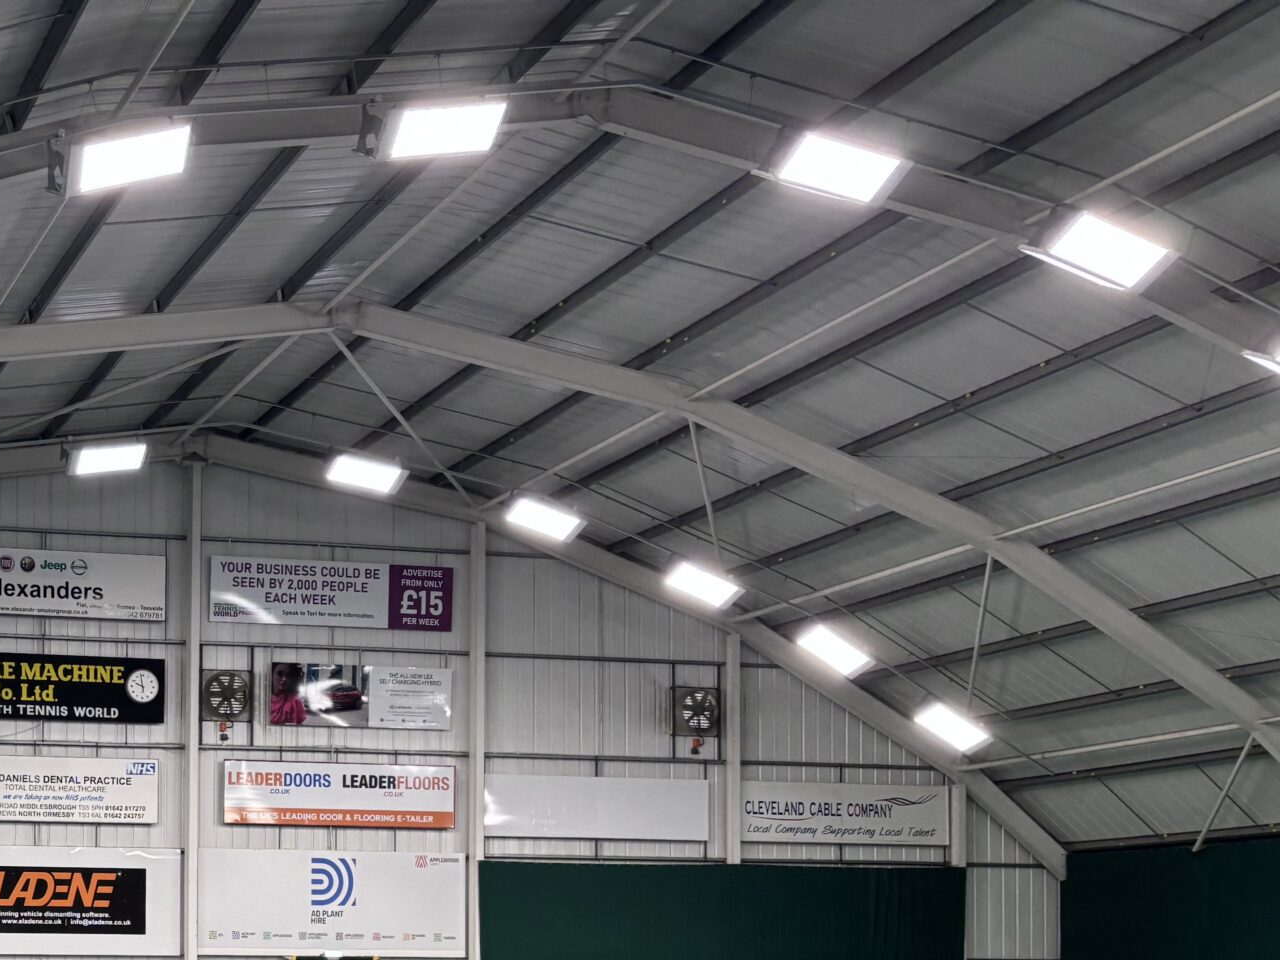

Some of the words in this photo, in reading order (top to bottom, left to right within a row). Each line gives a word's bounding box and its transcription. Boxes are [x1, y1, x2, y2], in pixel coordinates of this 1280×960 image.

[40, 560, 67, 572] Jeep
[220, 561, 252, 573] YOUR
[256, 563, 317, 577] BUSINESS
[321, 566, 361, 578] COULD
[365, 568, 381, 580] BE
[402, 569, 443, 578] ADVERTISE
[232, 576, 265, 588] SEEN
[269, 577, 284, 589] BY
[287, 579, 318, 591] 2,000
[321, 580, 369, 593] PEOPLE
[401, 579, 422, 587] FROM
[424, 580, 443, 588] ONLY
[265, 591, 297, 604] EACH
[301, 593, 336, 605] WEEK
[400, 589, 443, 616] £15
[402, 617, 417, 625] PER
[418, 618, 440, 626] WEEK
[20, 662, 125, 683] MACHINE
[20, 683, 58, 702] Ltd.
[16, 704, 68, 716] TENNIS
[73, 706, 120, 718] WORLD
[126, 763, 155, 775] NHS
[43, 775, 81, 784] DENTAL
[83, 776, 132, 786] PRACTICE
[227, 771, 332, 788] LEADERDOORS
[342, 774, 450, 790] LEADERFLOORS
[28, 784, 57, 792] DENTAL
[58, 785, 107, 793] HEALTHCARE
[24, 793, 43, 801] taking
[79, 794, 105, 802] patients
[745, 800, 804, 816] CLEVELAND
[810, 802, 842, 817] CABLE
[847, 803, 893, 818] COMPANY
[281, 812, 318, 820] LEADING
[319, 813, 343, 821] DOOR
[353, 814, 395, 822] FLOORING
[397, 815, 434, 823] E-TAILER
[747, 824, 771, 833] Local
[775, 824, 818, 838] Company
[821, 825, 875, 838] Supporting
[879, 826, 903, 837] Local
[907, 827, 936, 837] Talent
[322, 910, 343, 918] PLANT
